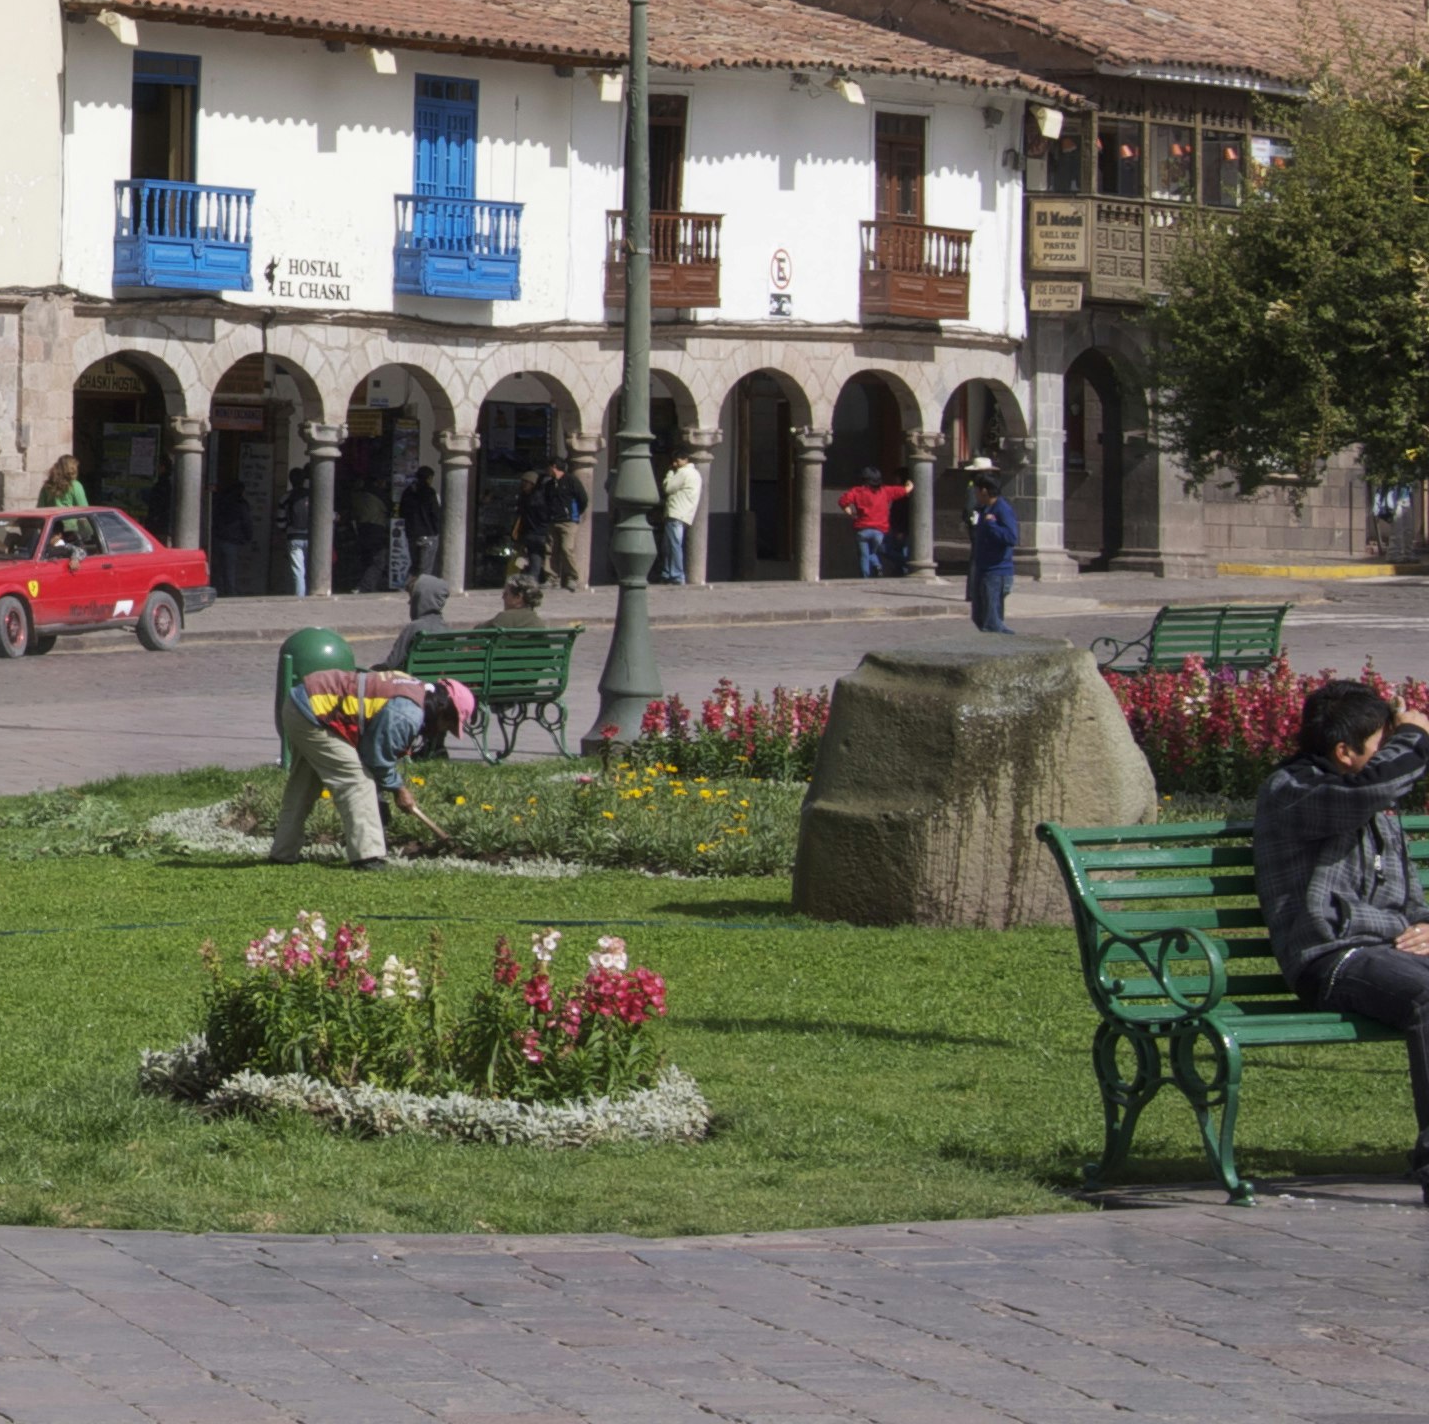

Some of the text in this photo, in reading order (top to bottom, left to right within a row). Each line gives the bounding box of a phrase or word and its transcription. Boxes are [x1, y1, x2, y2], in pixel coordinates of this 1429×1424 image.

[1036, 211, 1048, 226] El
[1043, 242, 1076, 250] PASTAS
[1043, 253, 1076, 262] PIZZAS
[288, 258, 342, 278] HOSTAL
[279, 281, 351, 301] EL CHASKI
[1049, 285, 1078, 295] ENTRANCE
[1037, 298, 1052, 308] 105
[105, 362, 115, 374] EL
[79, 375, 142, 392] CHASKI HOSTAL
